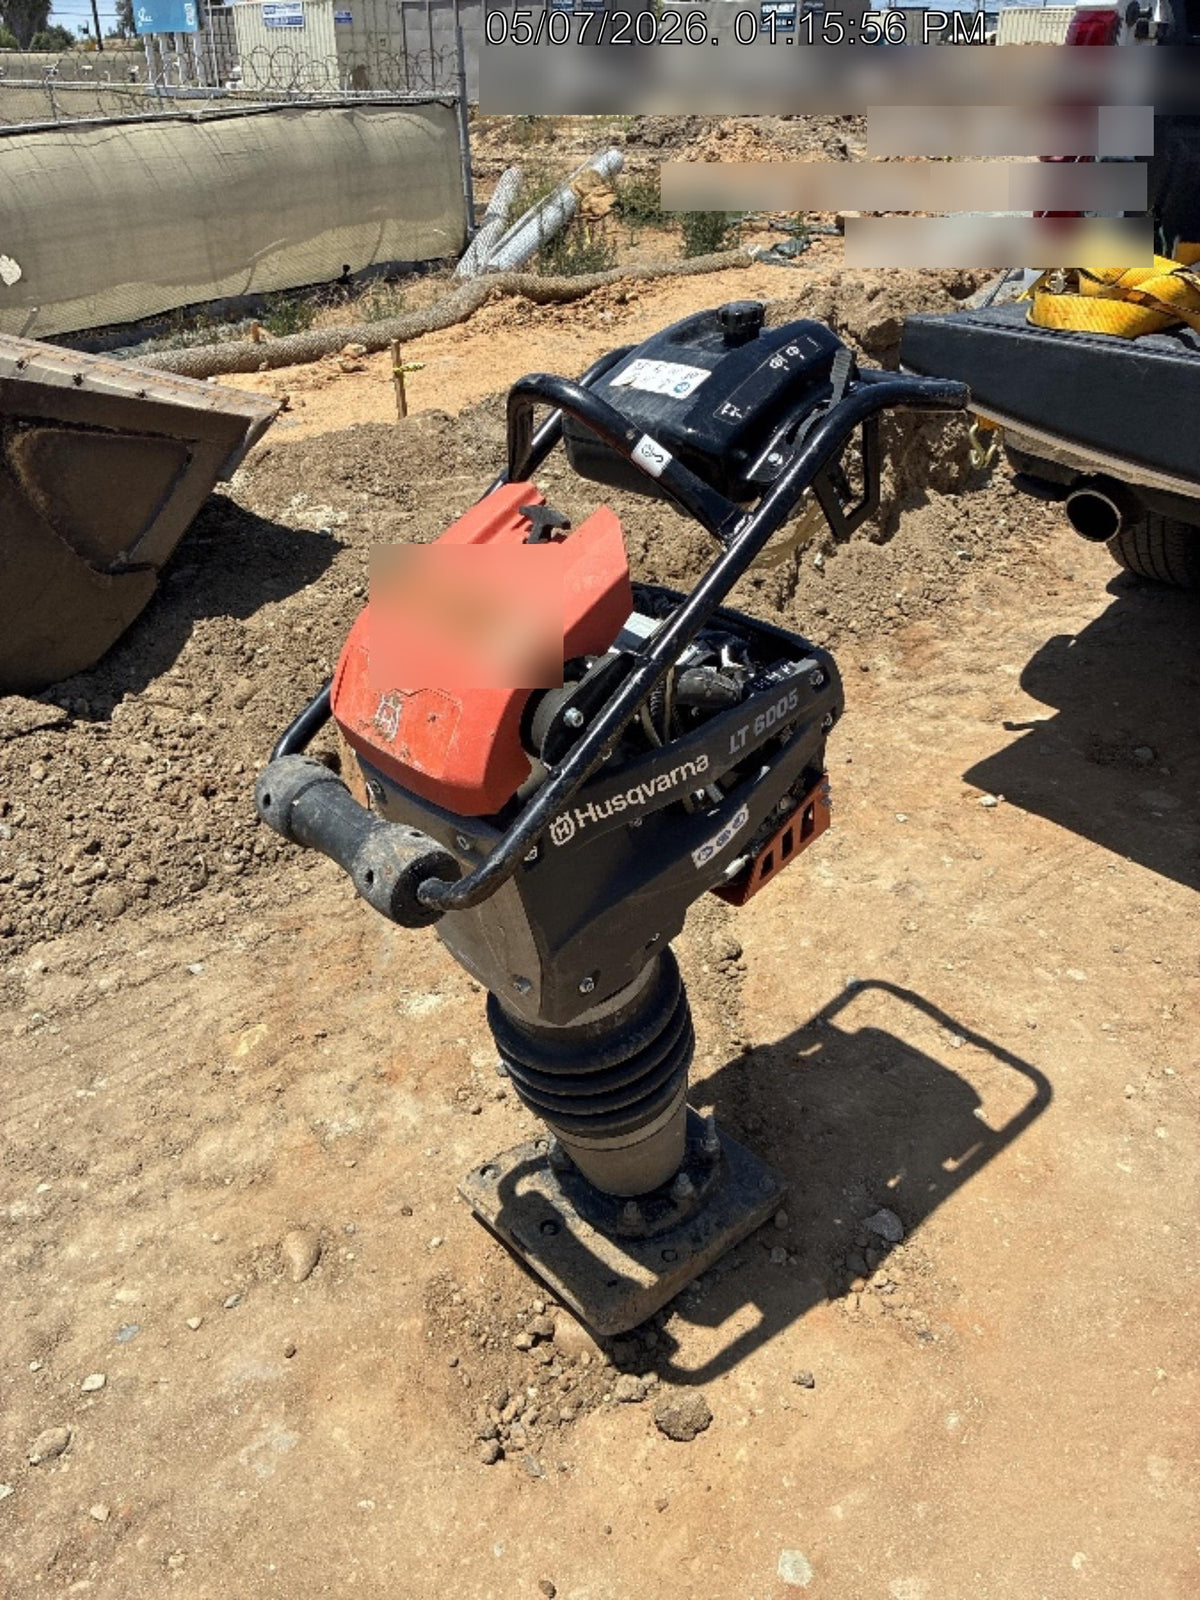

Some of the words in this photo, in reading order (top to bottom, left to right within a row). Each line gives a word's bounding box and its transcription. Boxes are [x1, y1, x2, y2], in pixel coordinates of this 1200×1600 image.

[728, 724, 749, 754] LT
[754, 687, 798, 736] 6005
[574, 753, 709, 828] Husqvarna
